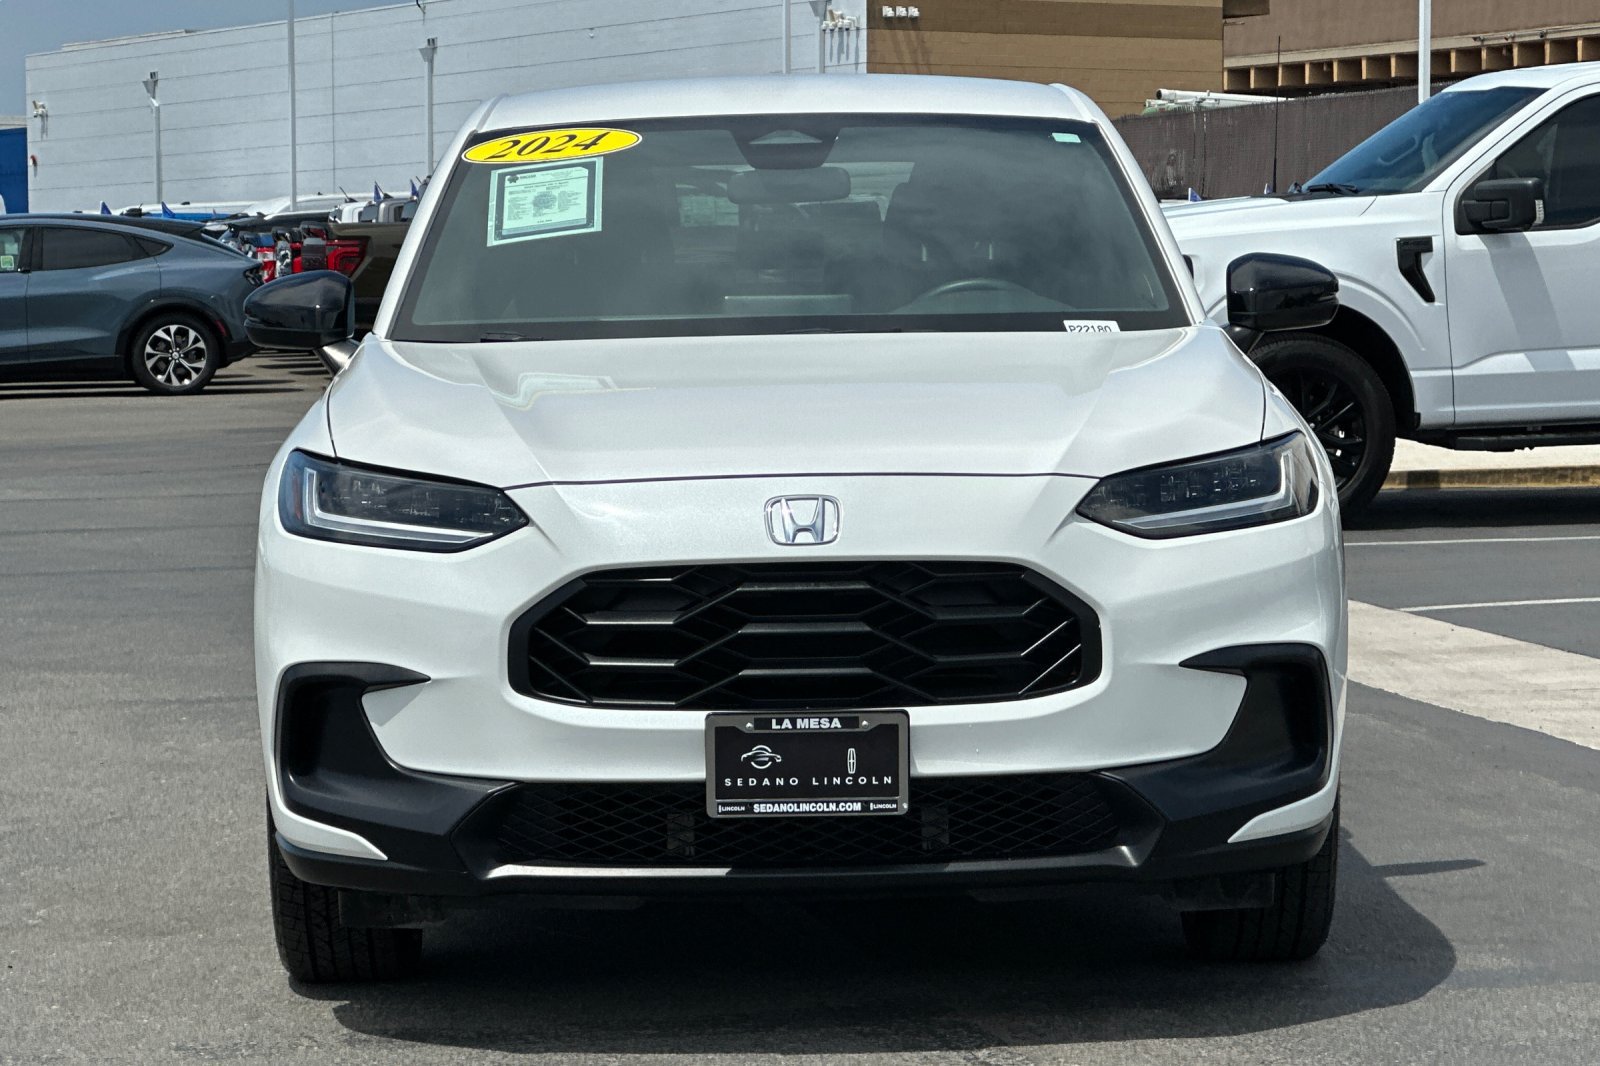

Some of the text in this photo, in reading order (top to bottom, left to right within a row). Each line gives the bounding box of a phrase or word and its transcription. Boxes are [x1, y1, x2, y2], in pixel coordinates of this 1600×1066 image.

[483, 131, 611, 160] 2024
[771, 717, 842, 729] LA MESA
[724, 776, 892, 787] SEDANO LINCOLN
[753, 802, 862, 813] SEDANOLINCOLN.COM
